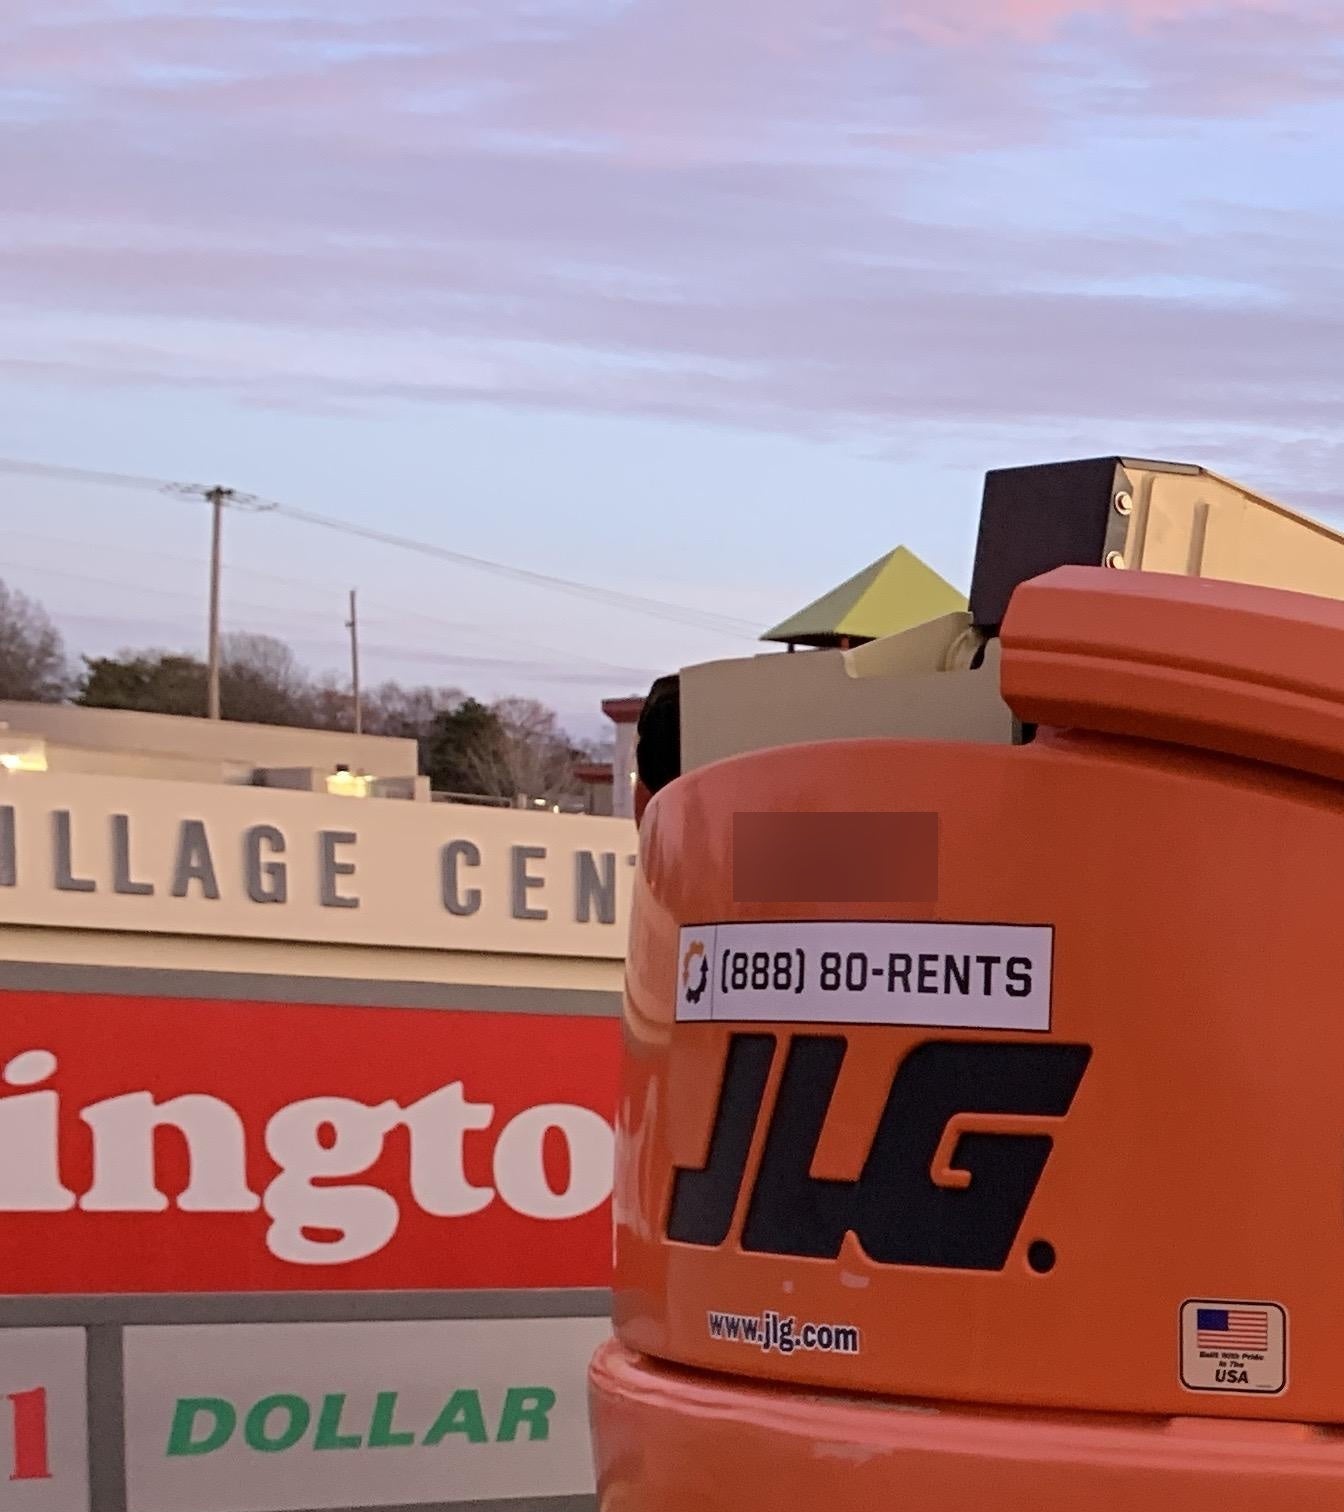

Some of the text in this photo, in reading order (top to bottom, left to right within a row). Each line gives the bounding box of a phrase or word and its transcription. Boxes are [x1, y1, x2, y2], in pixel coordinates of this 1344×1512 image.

[440, 838, 637, 925] CEN
[720, 948, 1033, 998] (888) 80-RENTS
[707, 1311, 860, 1353] www.jlg.com
[1215, 1369, 1249, 1383] USA
[166, 1387, 557, 1458] DOLLAR
